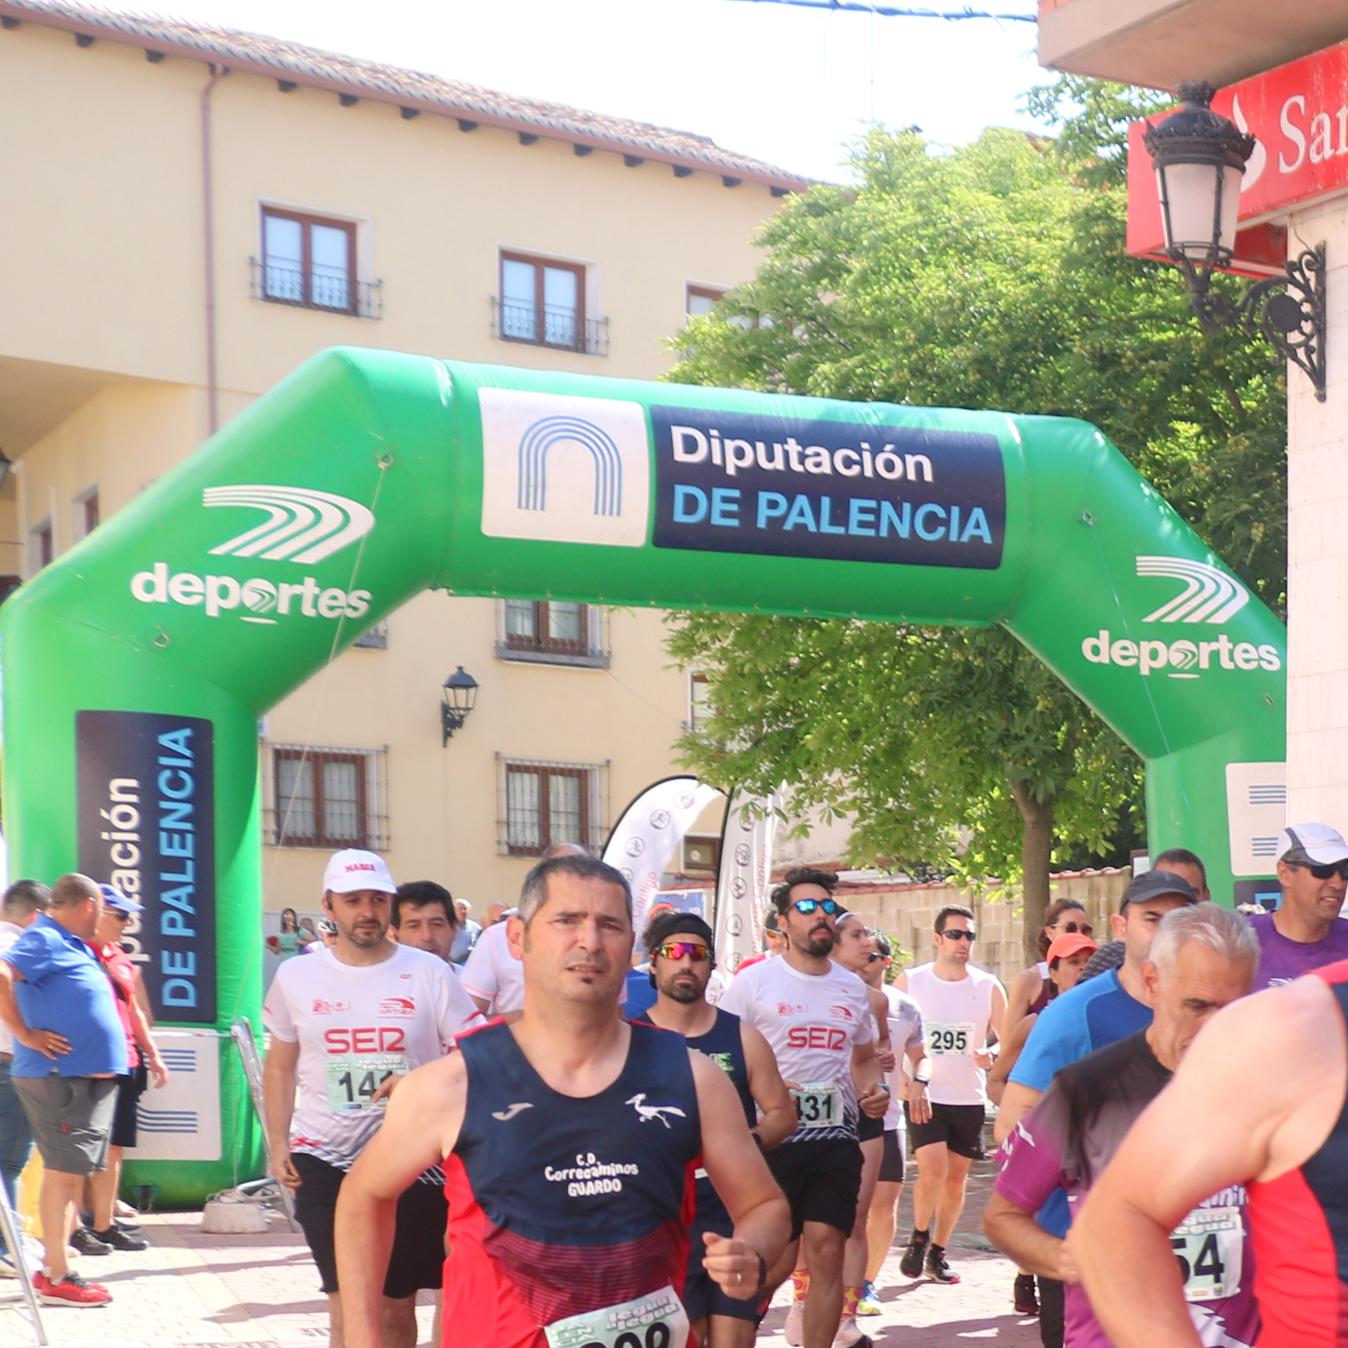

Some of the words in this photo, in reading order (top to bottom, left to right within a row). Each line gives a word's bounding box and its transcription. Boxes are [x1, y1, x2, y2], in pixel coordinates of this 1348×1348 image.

[670, 425, 933, 483] Diputación
[673, 484, 740, 527] DE
[756, 490, 993, 544] PALENCIA
[130, 562, 372, 620] deportes
[1081, 629, 1281, 676] deportes
[157, 727, 196, 937] PALENCIA
[160, 950, 198, 1008] DE
[324, 1027, 405, 1054] SER
[787, 1026, 848, 1050] SER
[931, 1030, 967, 1050] 295
[339, 1070, 394, 1102] 14
[544, 1162, 639, 1182] Correcaminos
[567, 1178, 622, 1198] GUARDO
